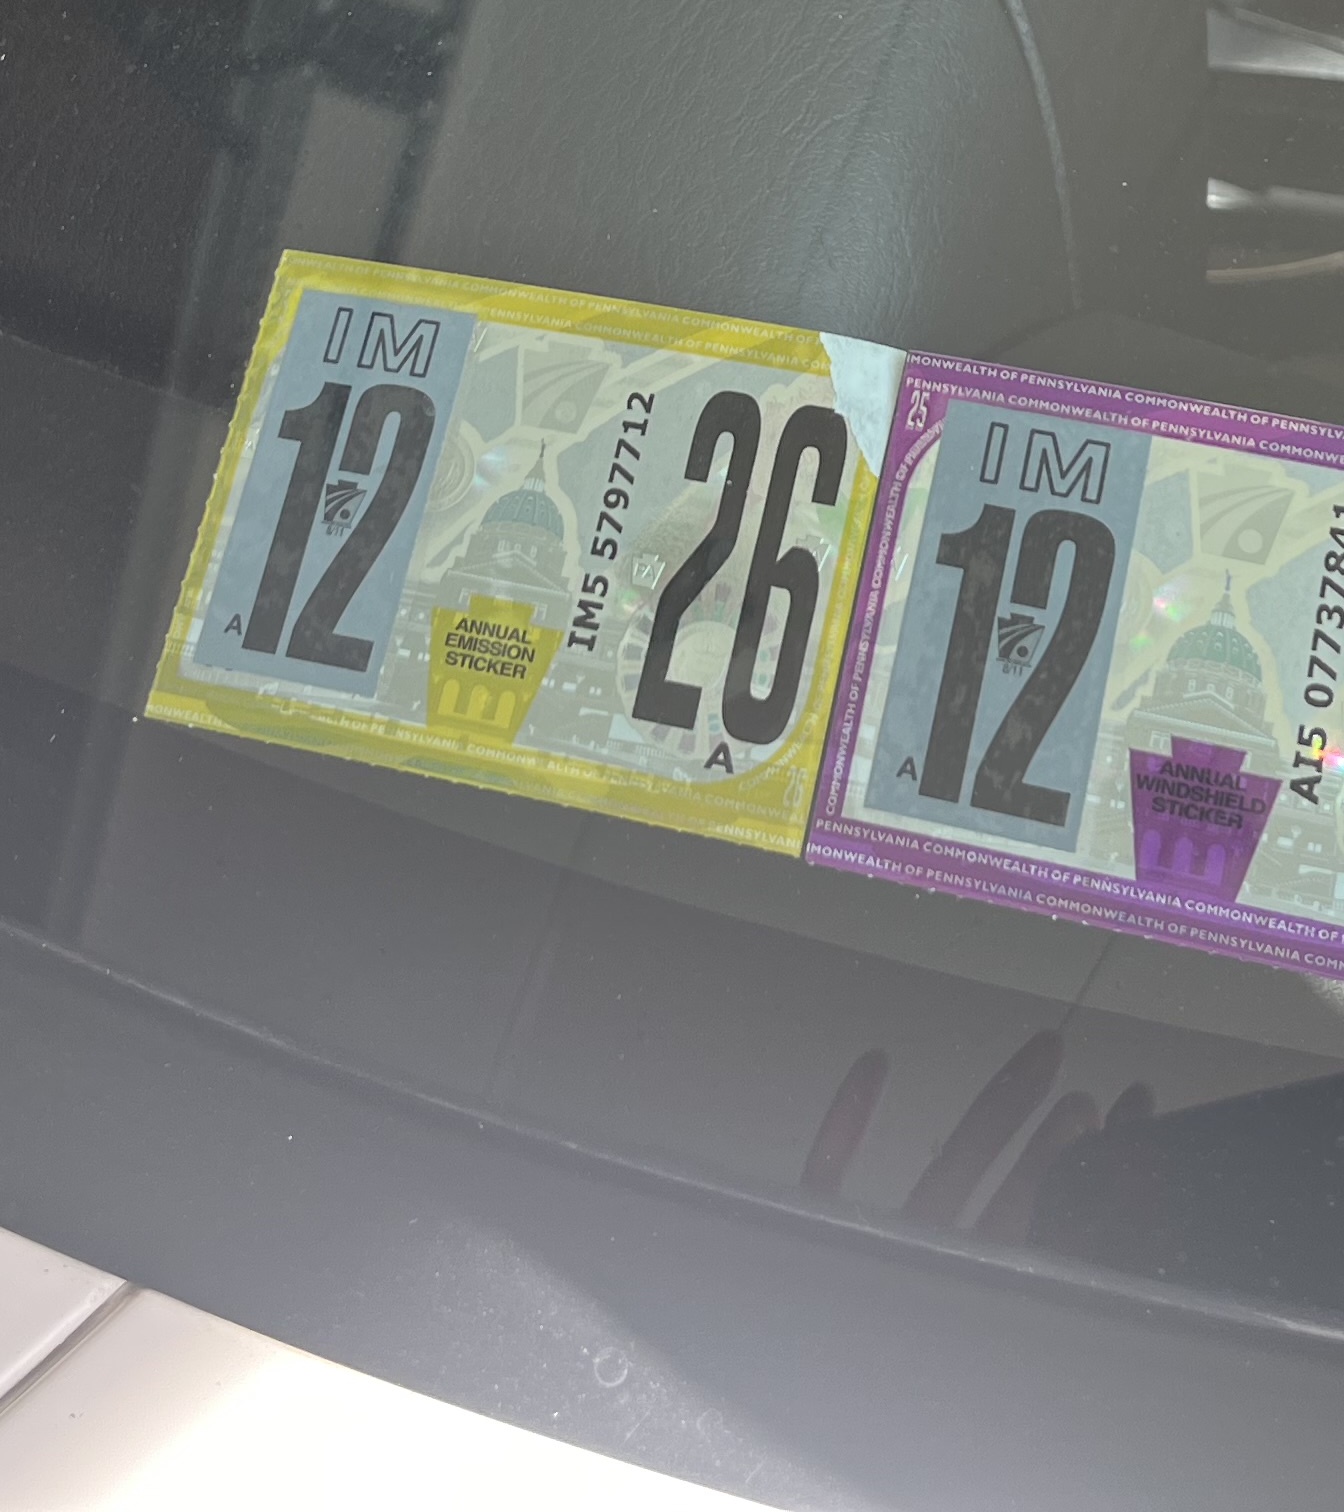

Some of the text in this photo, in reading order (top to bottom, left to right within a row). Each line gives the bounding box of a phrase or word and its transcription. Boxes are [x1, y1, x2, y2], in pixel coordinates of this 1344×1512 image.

[323, 307, 440, 378] IM
[461, 280, 568, 306] COMMONWEALTH
[570, 298, 586, 308] OF
[586, 300, 680, 324] PENNSYLVANIA
[680, 315, 794, 342] COMMONWEALTH
[794, 333, 812, 345] OF
[703, 341, 798, 365] PENNSYLVANIA
[905, 376, 1006, 404] PENNSYLVANIA
[1007, 393, 1128, 426] COMMONWEALTH
[1129, 416, 1150, 428] OF
[1151, 419, 1256, 448] PENNSYLVANIA
[998, 369, 1018, 381] OF
[1019, 372, 1121, 400] PENNSYLVANIA
[1124, 391, 1248, 422] COMMONWEALTH
[1249, 413, 1269, 426] OF
[979, 421, 1111, 505] IM
[242, 382, 435, 673] 12
[567, 392, 654, 652] IM5 5797712
[631, 390, 848, 745] 26
[224, 613, 243, 636] A
[444, 632, 536, 663] EMISSION
[455, 617, 532, 644] ANNUAL
[444, 650, 528, 680] STICKER
[918, 504, 1116, 828] 12
[704, 742, 734, 775] A
[825, 702, 857, 816] COMMONWEALTH
[848, 681, 860, 701] OF
[896, 756, 918, 782] A
[1159, 759, 1248, 792] ANNUAL
[1289, 725, 1328, 805] AI5
[1136, 773, 1267, 815] WINDSHIELD
[1151, 796, 1244, 830] STICKER
[815, 817, 919, 850] PENNSYLVANIA
[921, 840, 1049, 879] COMMONWEALTH
[1050, 869, 1070, 883] OF
[1072, 874, 1182, 908] PENNSYLVANIA
[1183, 898, 1316, 937] COMMONWEALTH
[1317, 928, 1339, 943] OF
[904, 863, 924, 877] OF
[925, 868, 1032, 901] PENNSYLVANIA
[1034, 892, 1164, 931] COMMONWEALTH
[1166, 921, 1187, 935] OF
[1189, 926, 1301, 961] PENNSYLVANIA
